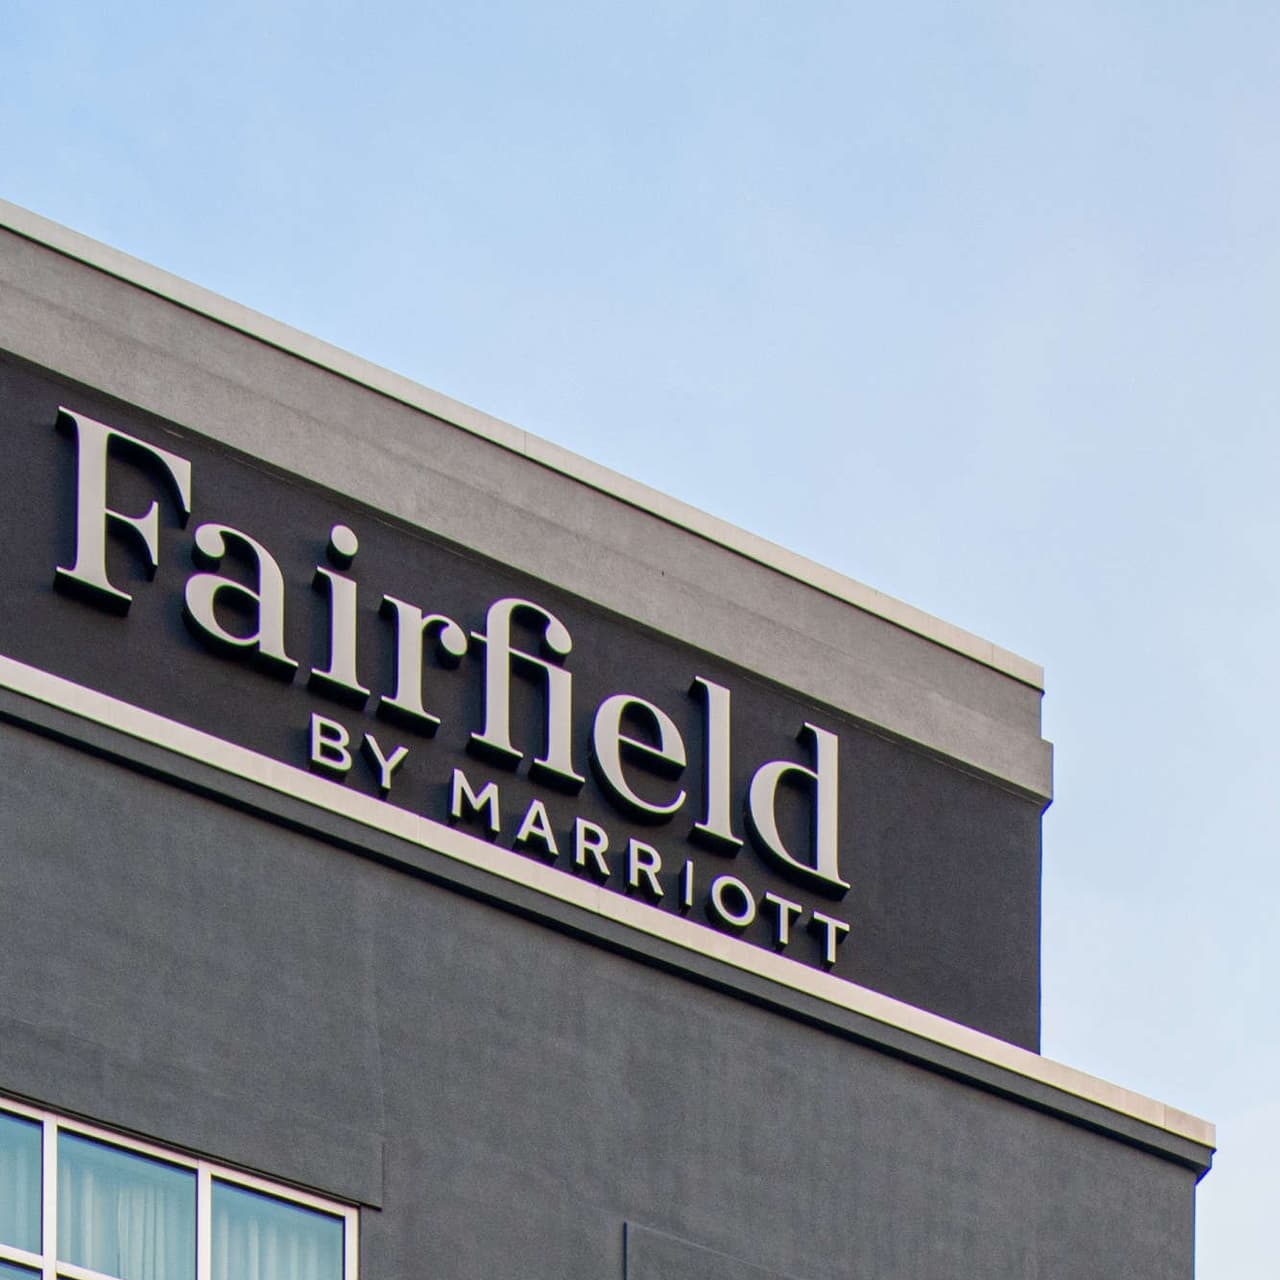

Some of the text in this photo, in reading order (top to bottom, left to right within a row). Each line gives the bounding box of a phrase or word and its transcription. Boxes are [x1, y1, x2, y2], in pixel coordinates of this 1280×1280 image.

[56, 406, 851, 892] Fairfield
[309, 713, 850, 966] BY MARRIOTT
